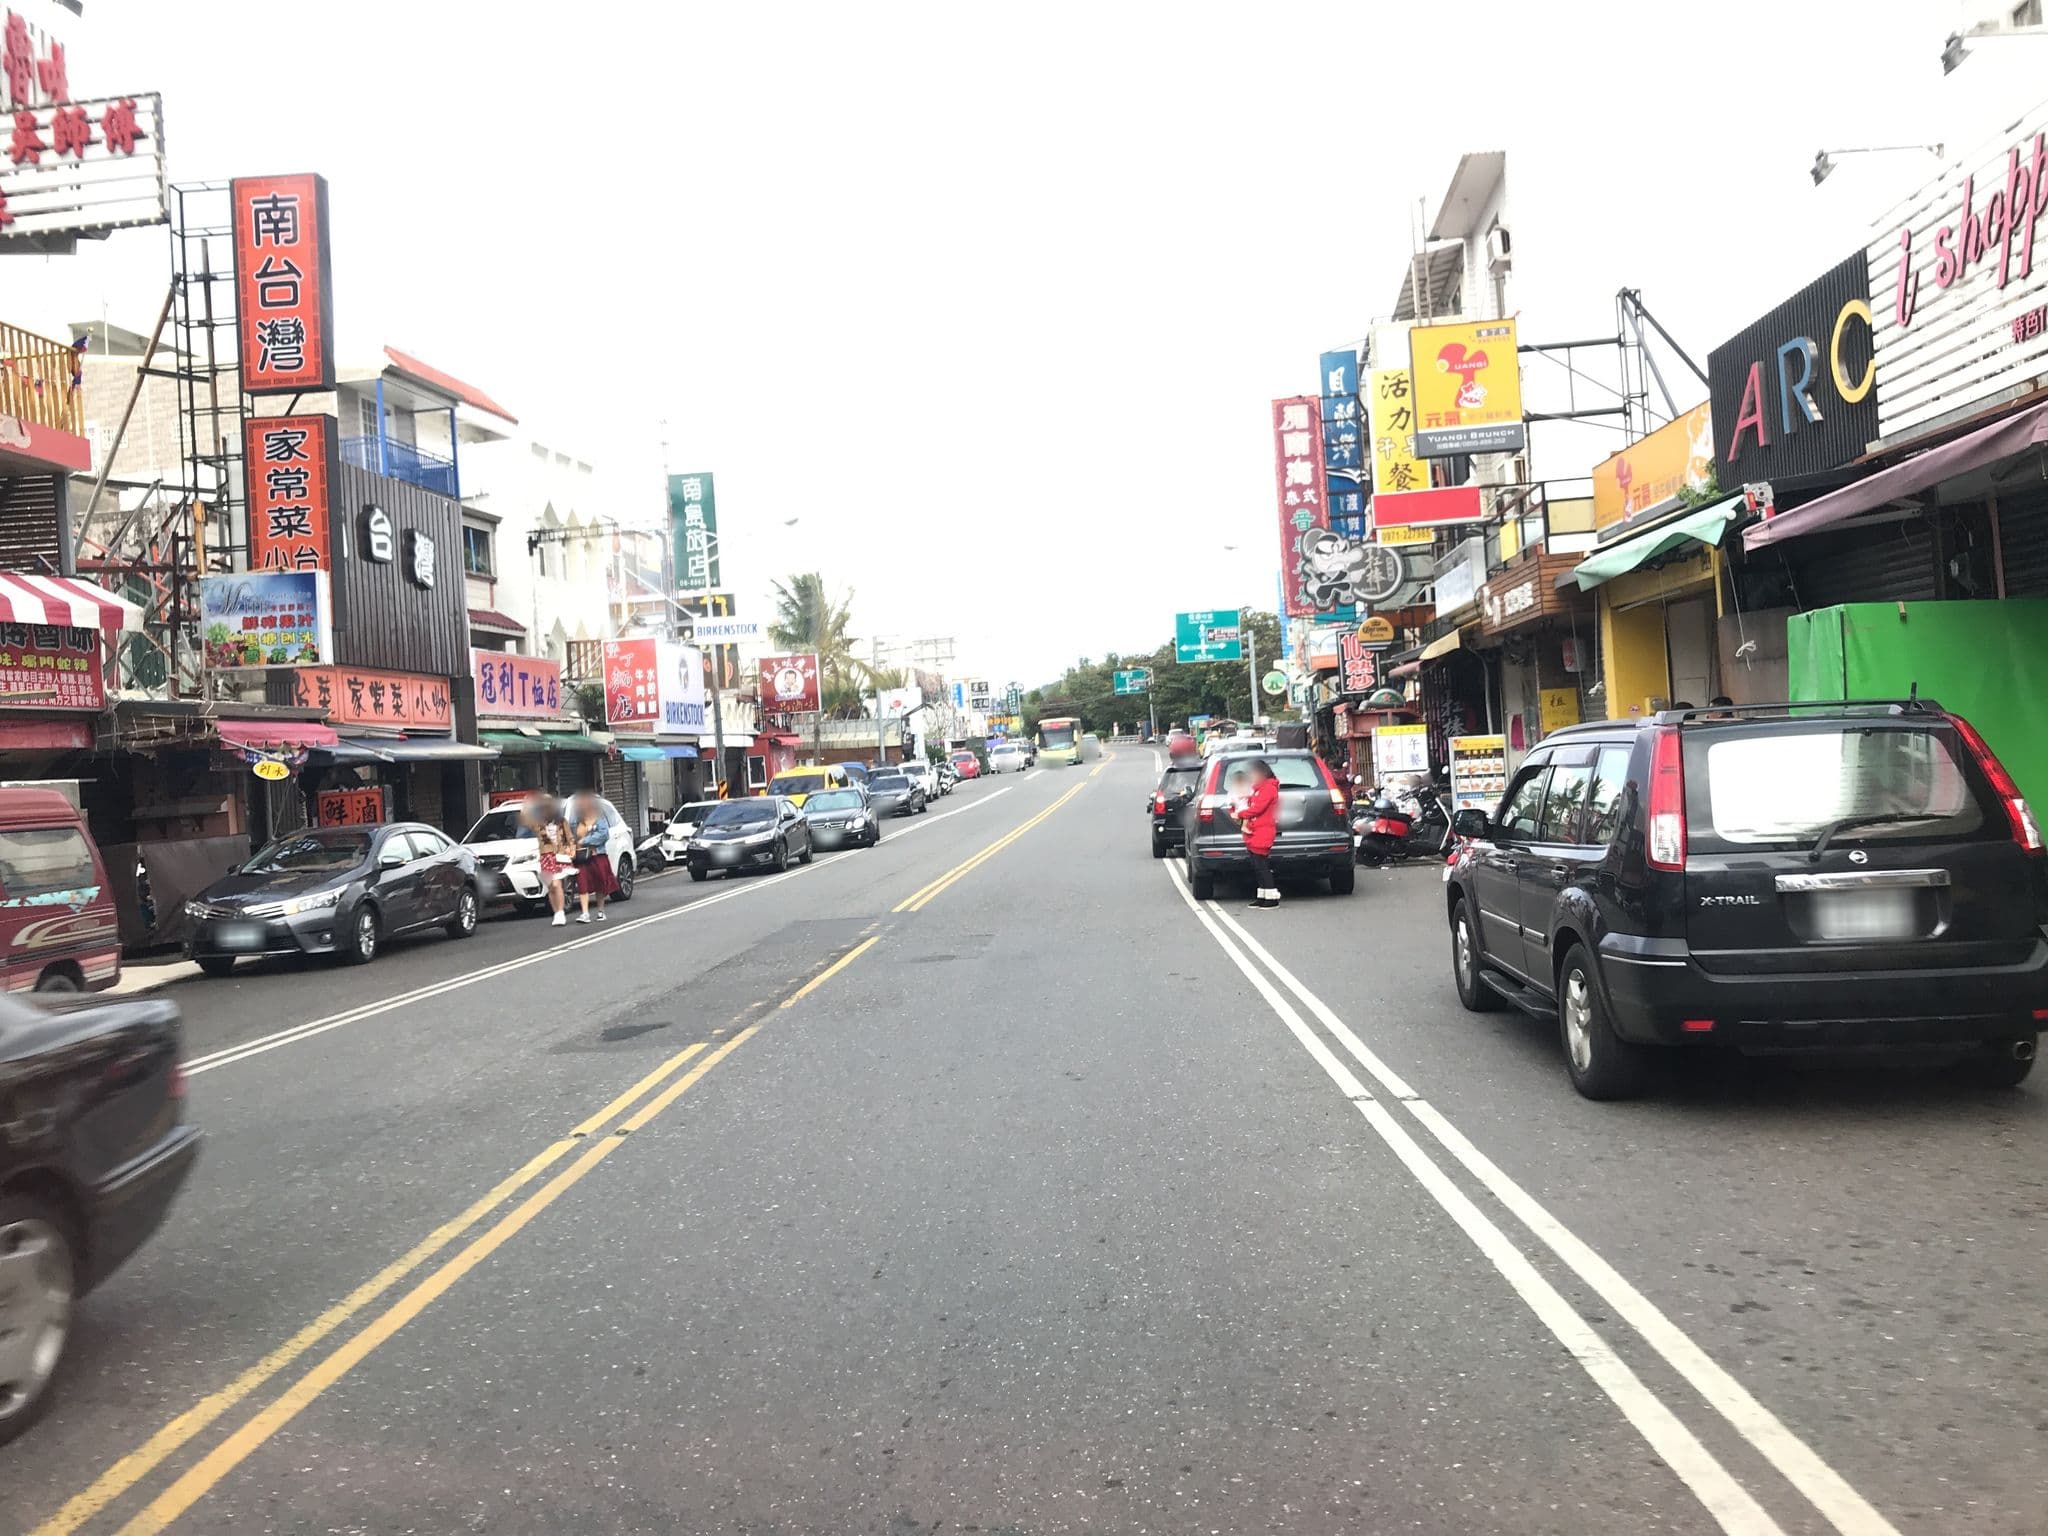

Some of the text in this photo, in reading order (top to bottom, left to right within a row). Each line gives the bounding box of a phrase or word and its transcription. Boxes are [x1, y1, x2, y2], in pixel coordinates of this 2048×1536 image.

[252, 193, 305, 372] 南台灣
[1727, 298, 1877, 463] ARC
[263, 429, 313, 539] 家常菜
[697, 624, 758, 638] BIRKENSTOCK
[481, 661, 558, 709] 冠利T恤店
[665, 700, 705, 726] BIRKENSTOCK
[1700, 895, 1760, 906] X-TRAIL
